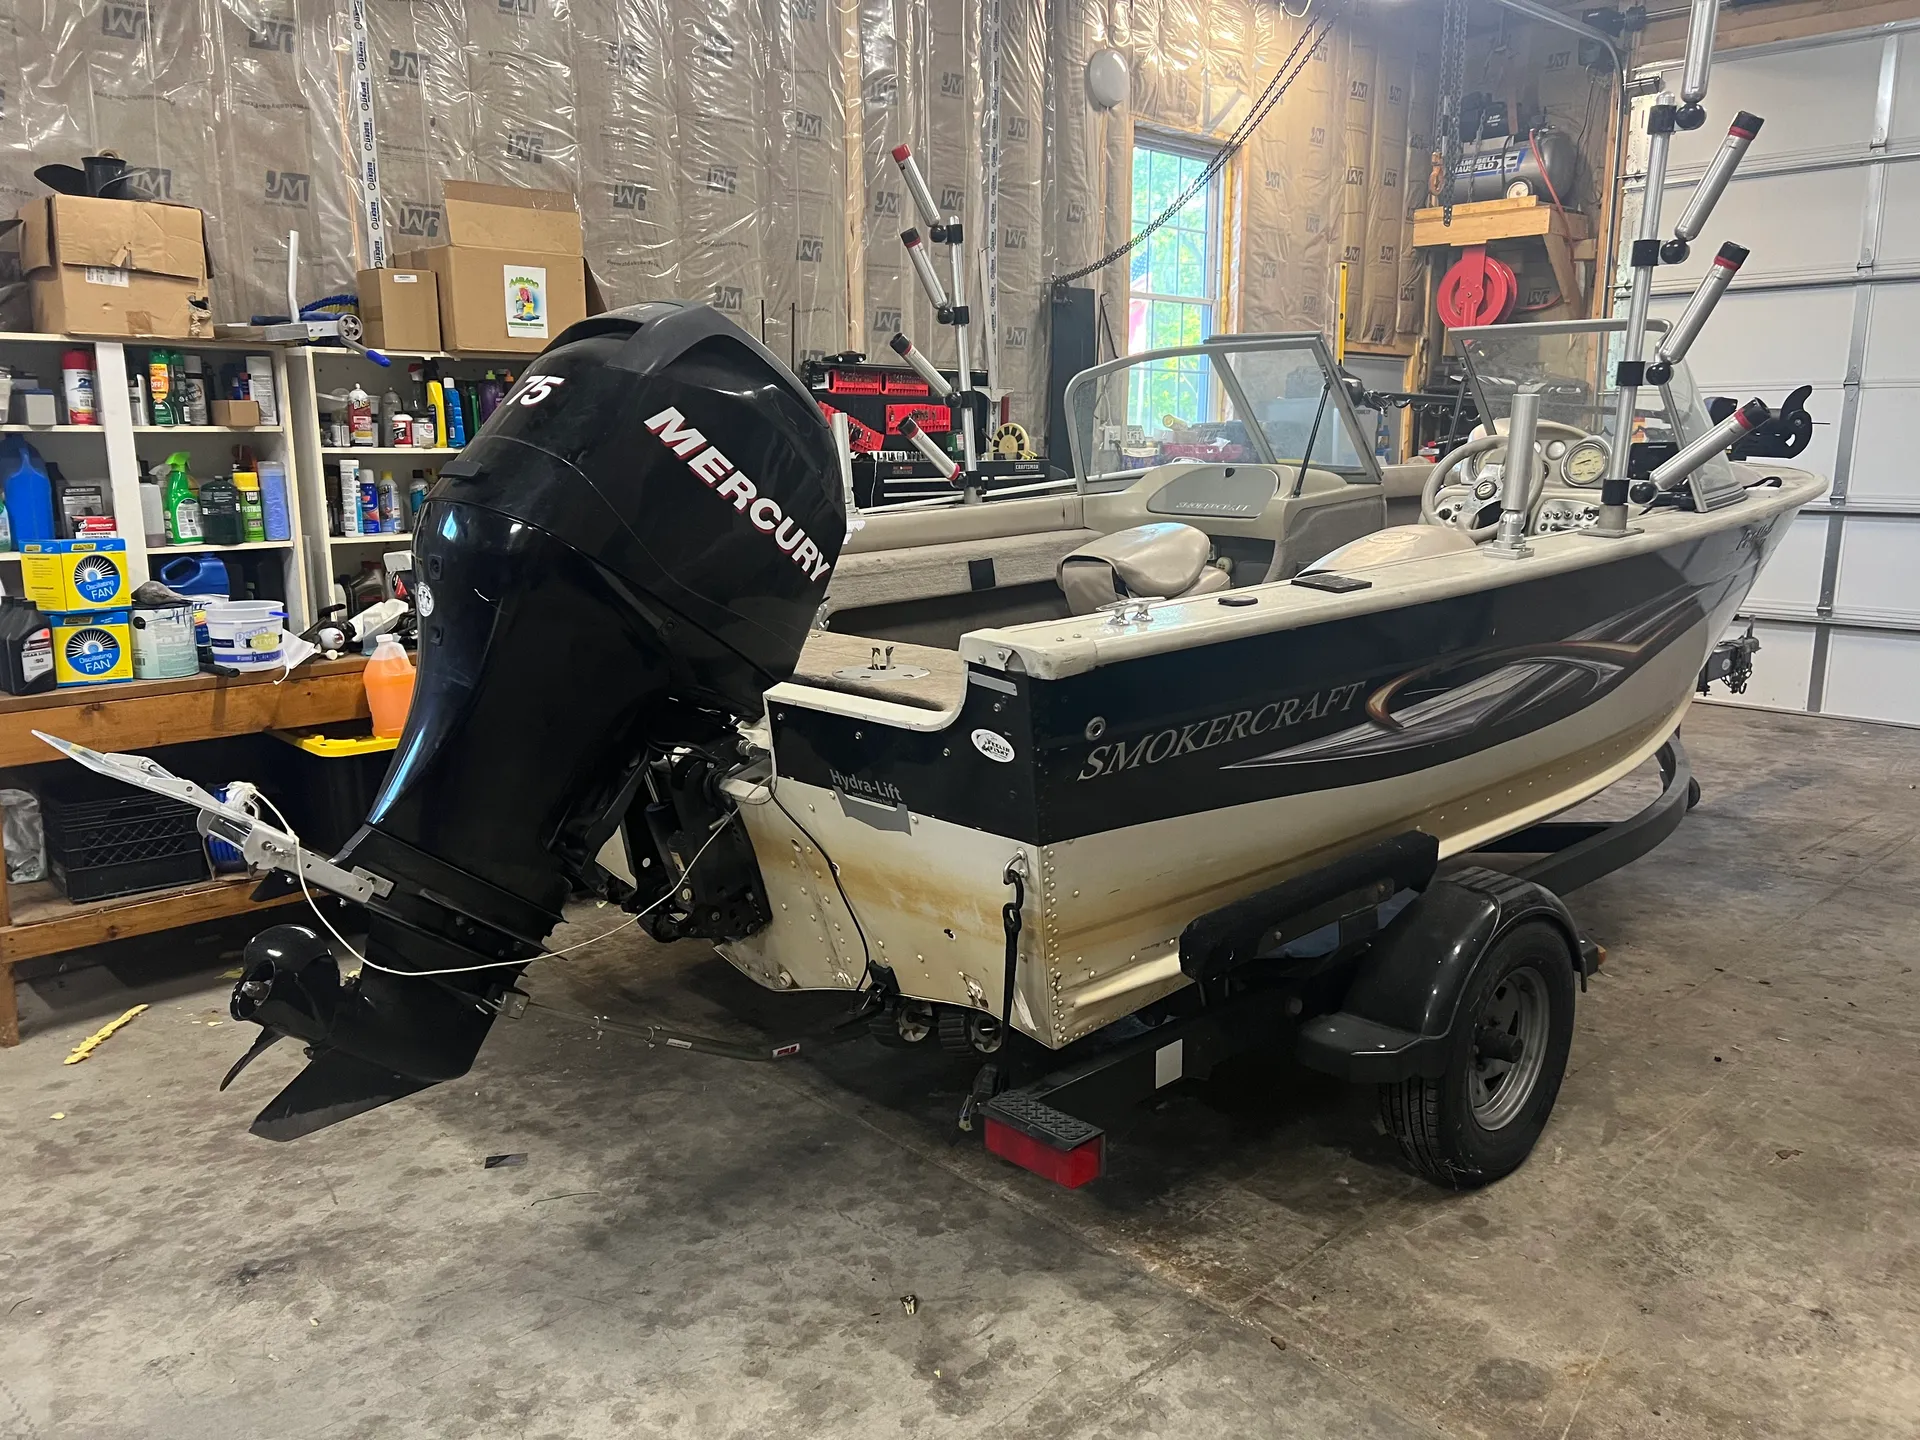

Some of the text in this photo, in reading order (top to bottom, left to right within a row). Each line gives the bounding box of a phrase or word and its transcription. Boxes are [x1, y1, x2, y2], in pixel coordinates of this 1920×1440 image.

[942, 72, 964, 97] JM
[1351, 80, 1368, 99] JM
[796, 112, 822, 138] JM
[1008, 117, 1029, 139] JM
[265, 170, 310, 201] JM
[613, 184, 647, 211] JM
[874, 192, 901, 213] JM
[941, 188, 965, 212] JM
[399, 206, 441, 237] JM
[1004, 228, 1027, 249] JM
[797, 239, 824, 262] JM
[1345, 246, 1360, 262] JM
[714, 286, 743, 310] JM
[873, 311, 901, 332] JM
[1006, 327, 1027, 346] JM
[151, 380, 164, 388] OFF!
[506, 375, 565, 406] 75
[643, 405, 832, 583] MERCURY
[86, 580, 115, 591] Oscillating
[91, 587, 114, 600] FAN
[79, 653, 112, 664] Oscillating
[85, 659, 111, 672] FAN
[1077, 681, 1367, 782] SMOKERCRAFT
[829, 768, 903, 802] Hydra-Lift
